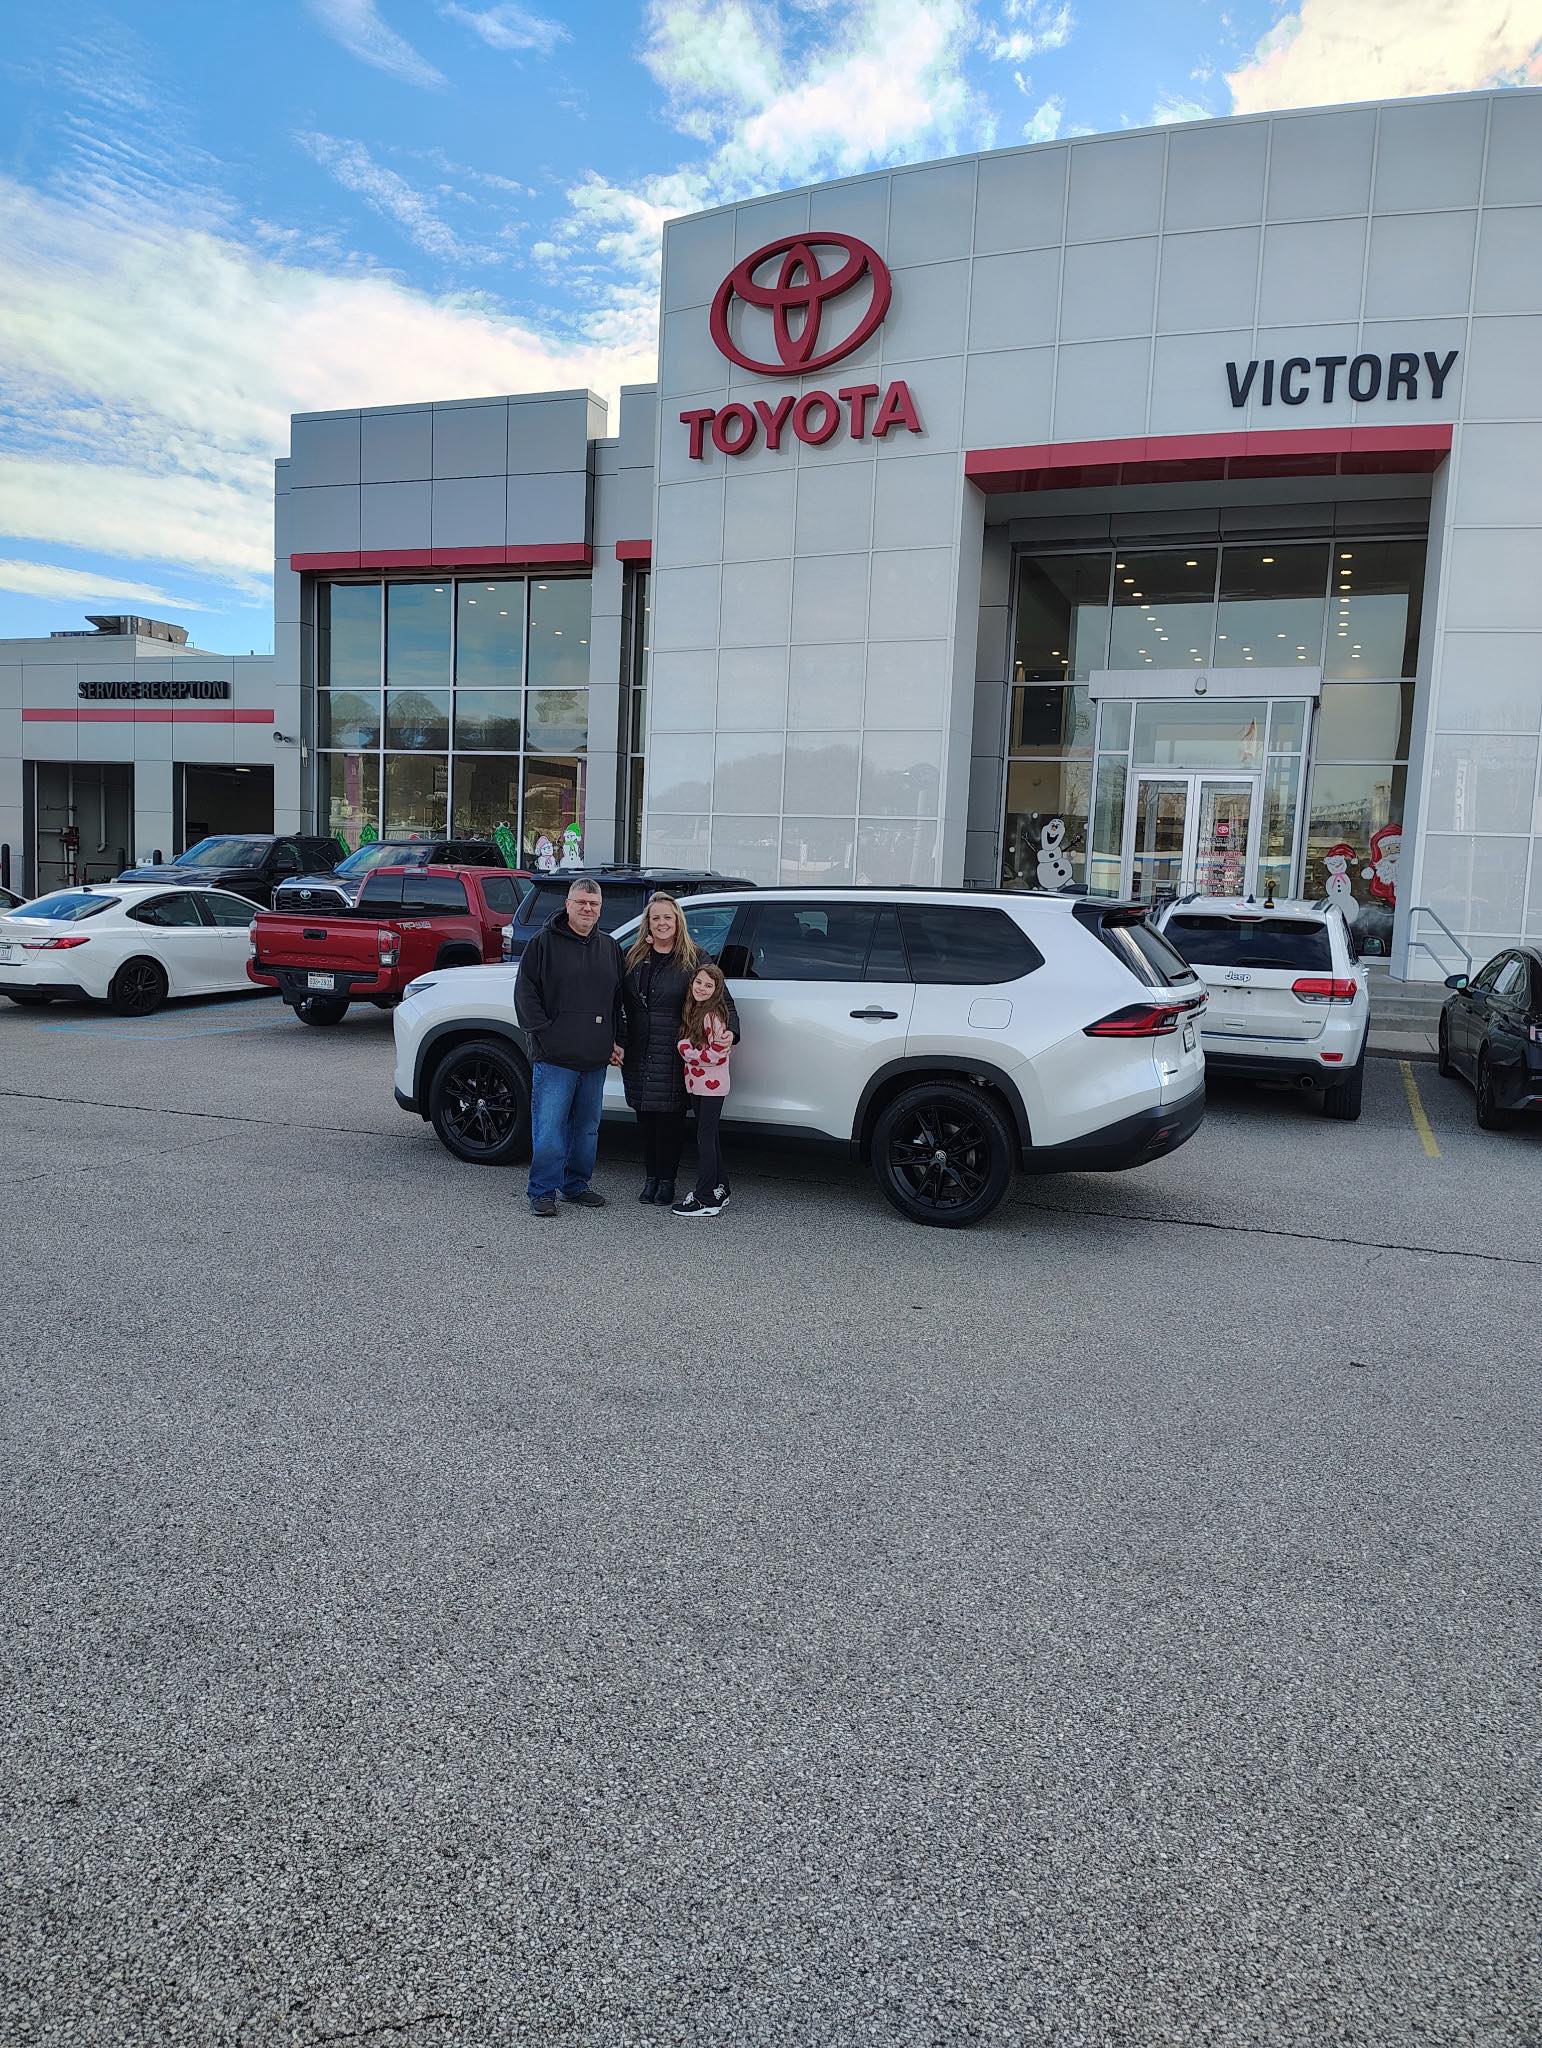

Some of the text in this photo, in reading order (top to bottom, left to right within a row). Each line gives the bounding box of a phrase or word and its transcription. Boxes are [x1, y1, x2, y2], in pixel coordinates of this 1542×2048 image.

[1226, 351, 1459, 407] VICTORY
[680, 380, 923, 460] TOYOTA
[78, 681, 231, 699] SERVICE RECEPTION
[1225, 971, 1252, 982] Jeep
